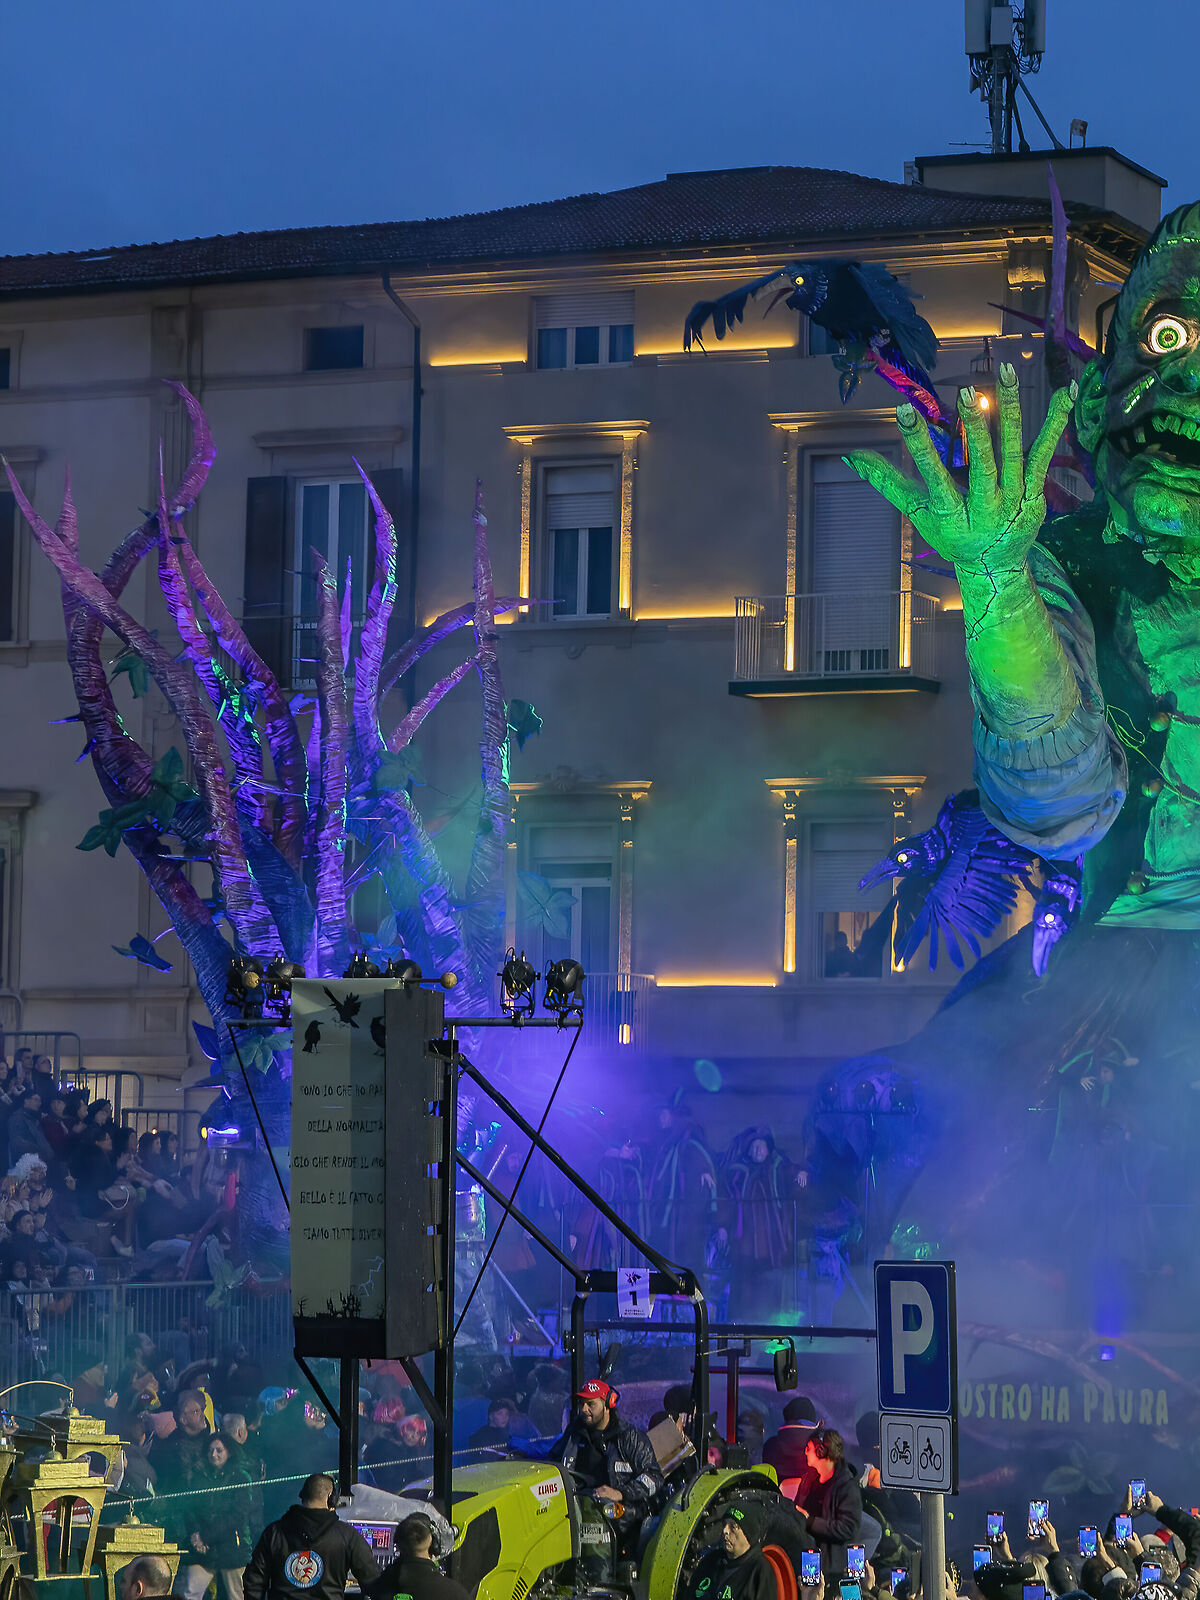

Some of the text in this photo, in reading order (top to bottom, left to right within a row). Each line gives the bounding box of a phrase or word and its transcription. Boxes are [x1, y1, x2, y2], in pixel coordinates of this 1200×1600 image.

[307, 1120, 332, 1132] DELLA
[312, 1156, 329, 1168] CHE
[332, 1155, 357, 1168] RENDE
[300, 1191, 327, 1204] BELLO
[629, 1291, 638, 1306] 1
[890, 1280, 934, 1394] P
[1041, 1386, 1070, 1423] HA
[1083, 1382, 1169, 1426] PAURA
